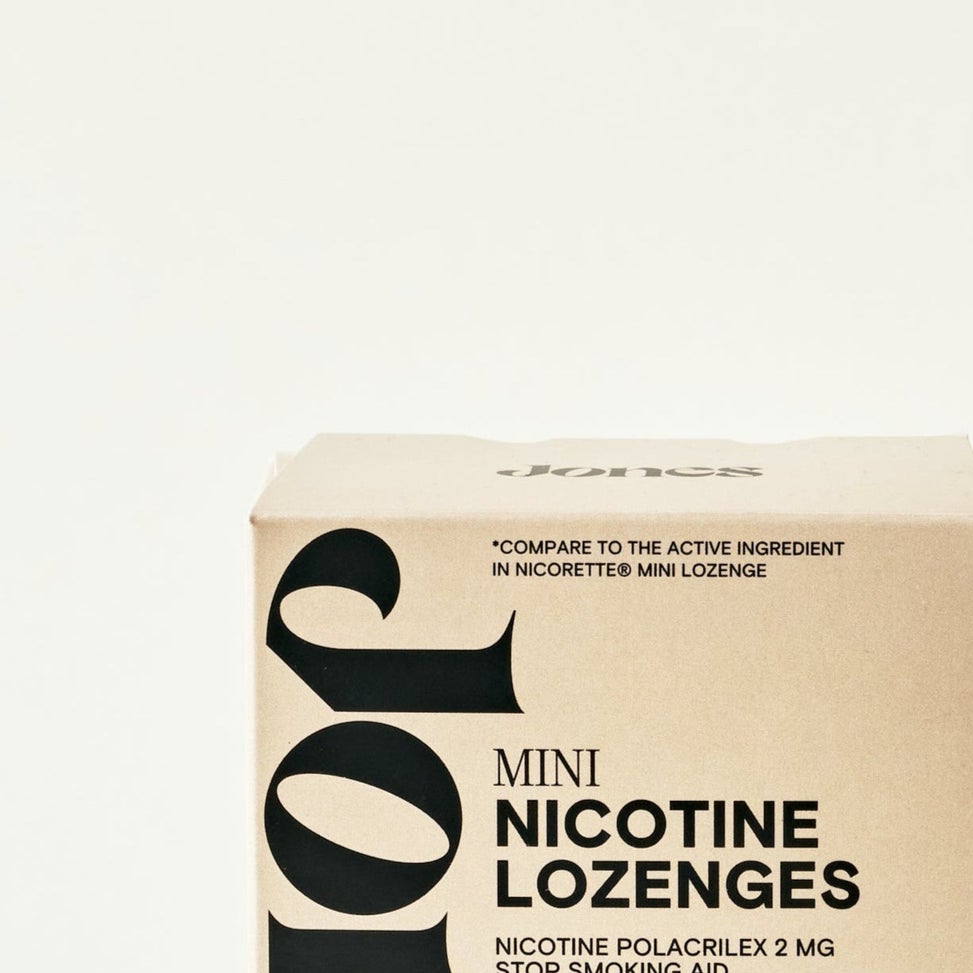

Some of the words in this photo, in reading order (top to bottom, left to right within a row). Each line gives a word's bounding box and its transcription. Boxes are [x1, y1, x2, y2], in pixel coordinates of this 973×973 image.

[496, 464, 764, 478] Jones
[597, 540, 622, 555] TO
[627, 541, 661, 555] THE
[667, 541, 731, 555] ACTIVE
[738, 541, 845, 556] INGREDIENT
[493, 562, 509, 576] IN
[638, 563, 675, 577] MINI
[682, 563, 766, 578] LOZENGE
[493, 748, 600, 788] MINI
[497, 799, 819, 848] NICOTINE
[497, 859, 860, 910] LOZENGES
[496, 937, 608, 956] NICOTINE
[617, 938, 767, 956] POLACRILEX
[775, 938, 787, 956] 2
[796, 938, 834, 957] MG
